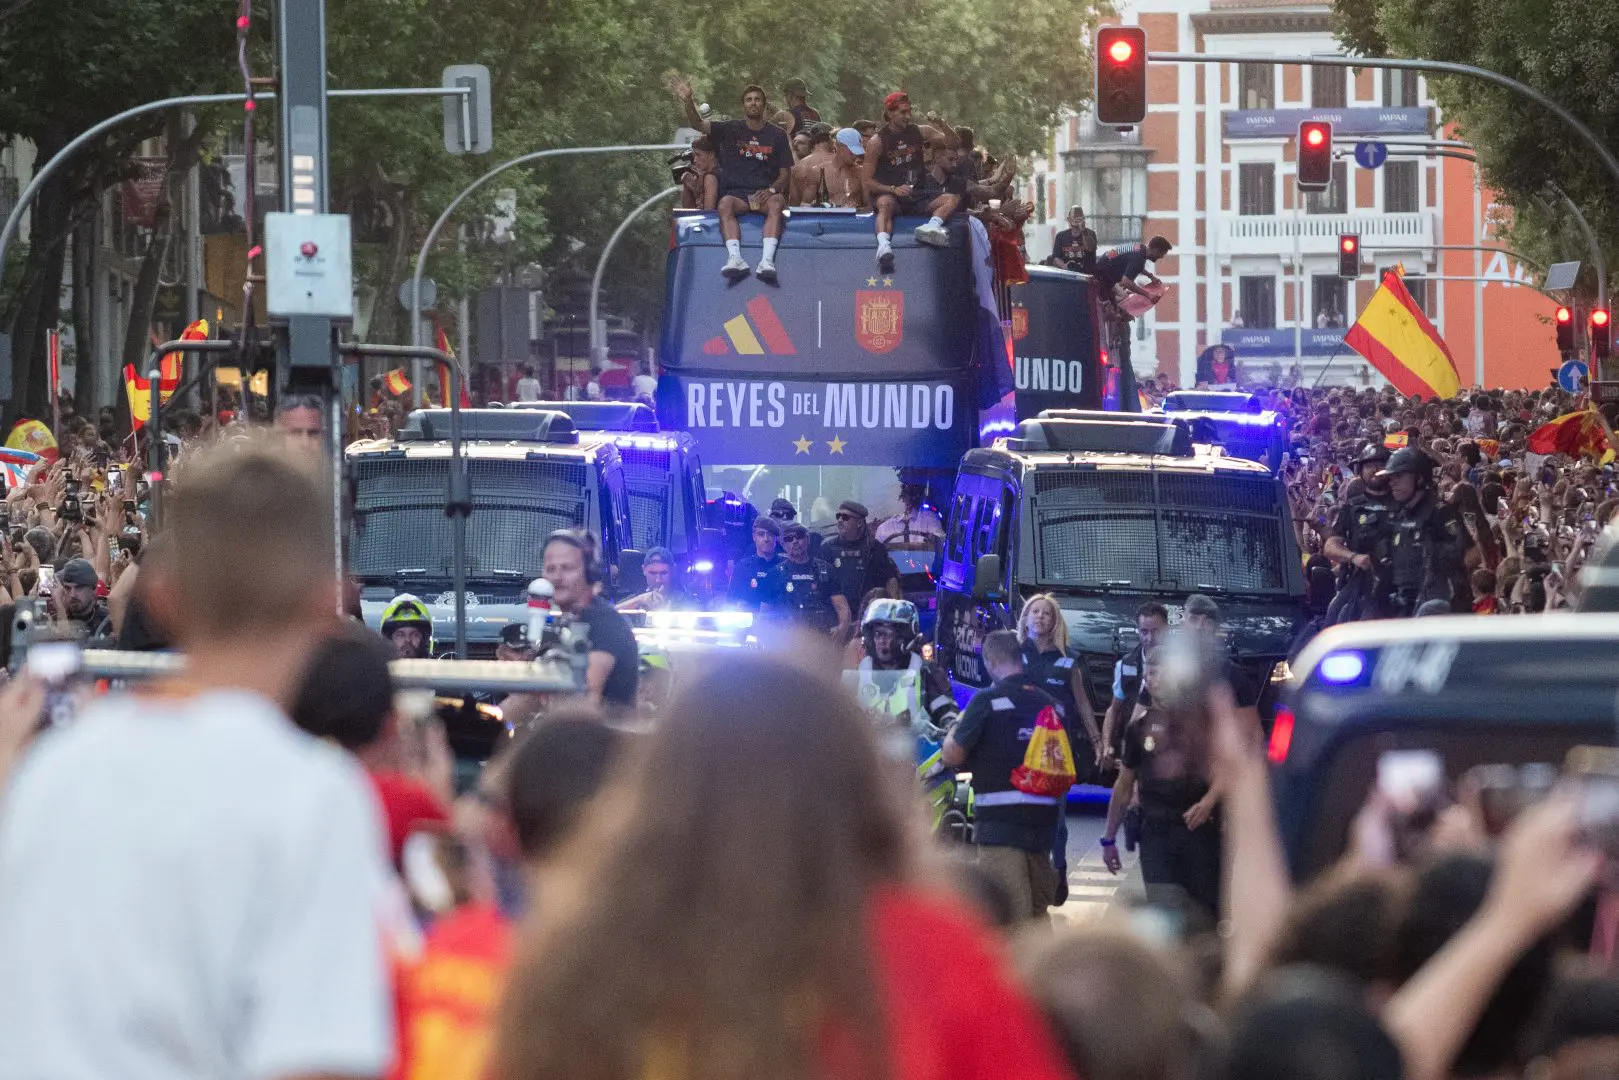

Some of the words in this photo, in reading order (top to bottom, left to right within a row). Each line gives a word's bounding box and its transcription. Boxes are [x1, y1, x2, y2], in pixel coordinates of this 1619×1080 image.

[1379, 113, 1408, 121] IMPAR
[687, 382, 785, 429] REYES
[792, 392, 820, 416] DEL
[823, 382, 954, 430] MUNDO
